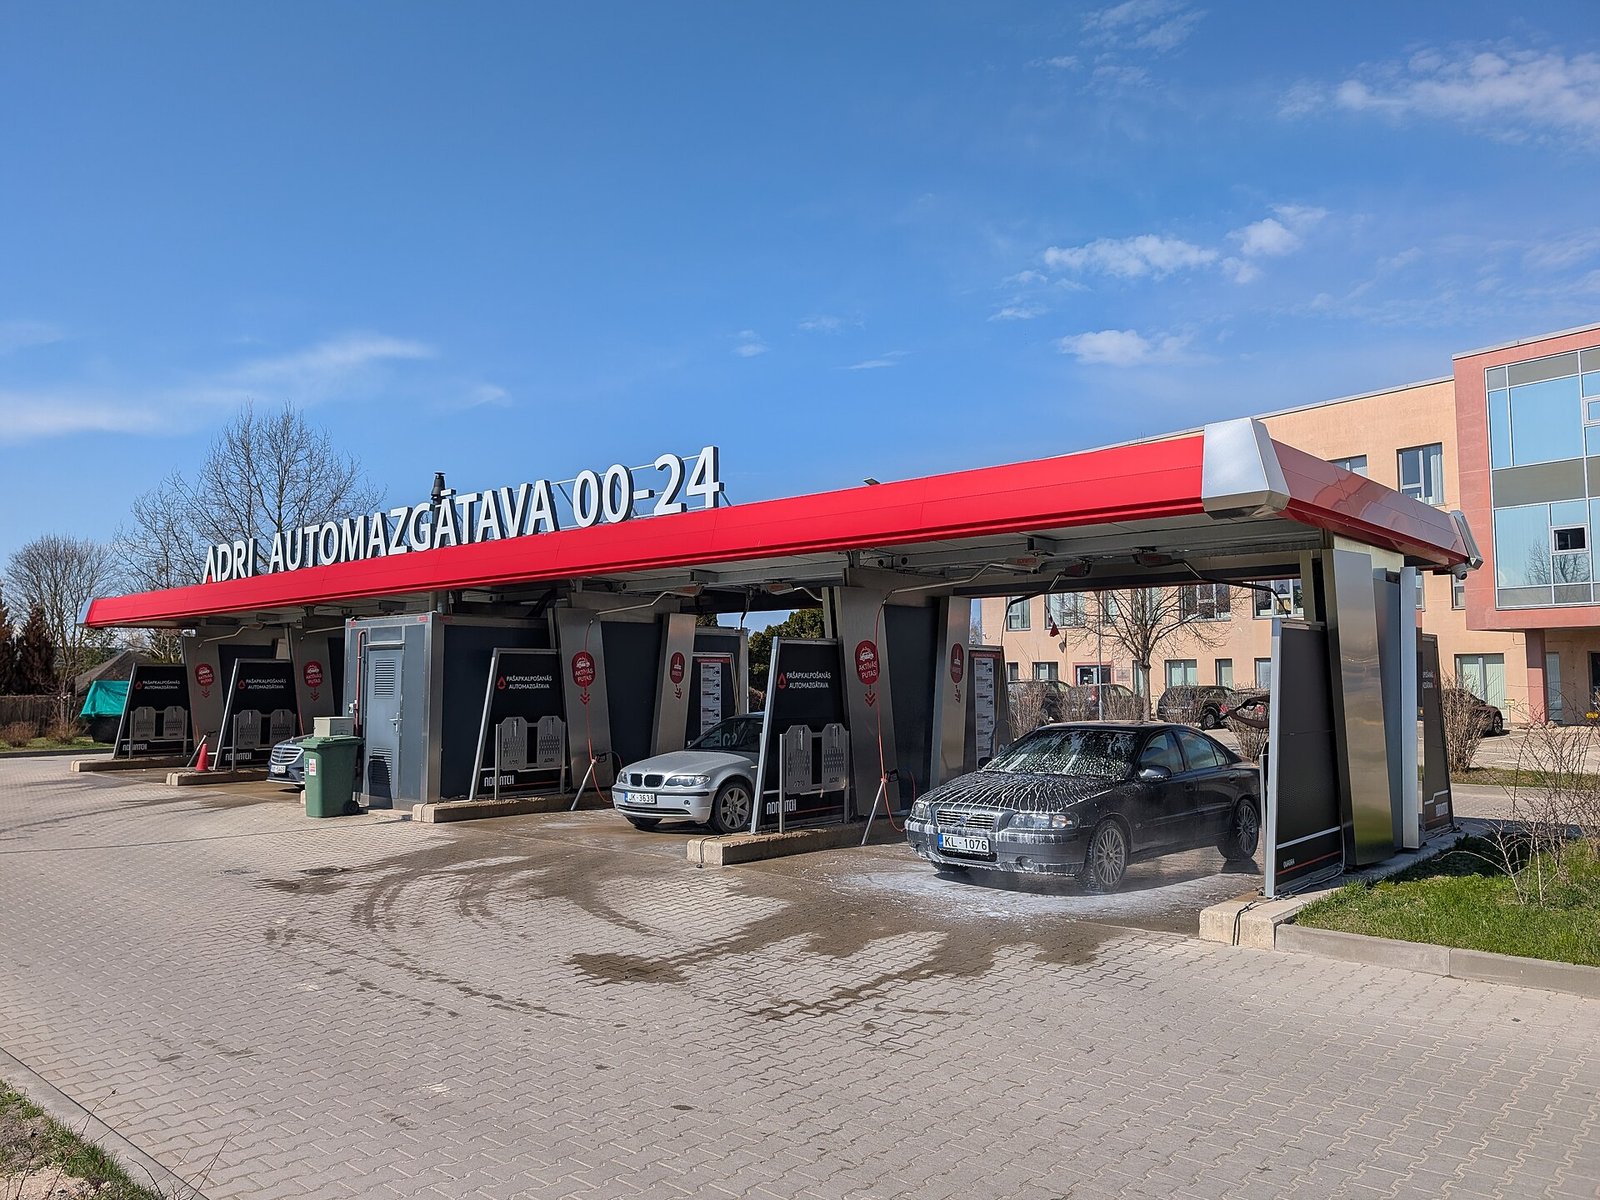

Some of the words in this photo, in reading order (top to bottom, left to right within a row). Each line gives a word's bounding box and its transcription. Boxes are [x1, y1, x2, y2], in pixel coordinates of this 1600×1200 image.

[202, 538, 257, 584] ADRI
[269, 480, 558, 574] AUTOMAZGĀTAVA
[572, 446, 724, 528] 00-24
[861, 669, 877, 679] PUTAS
[788, 681, 829, 689] AUTOMAZGĀTAVA
